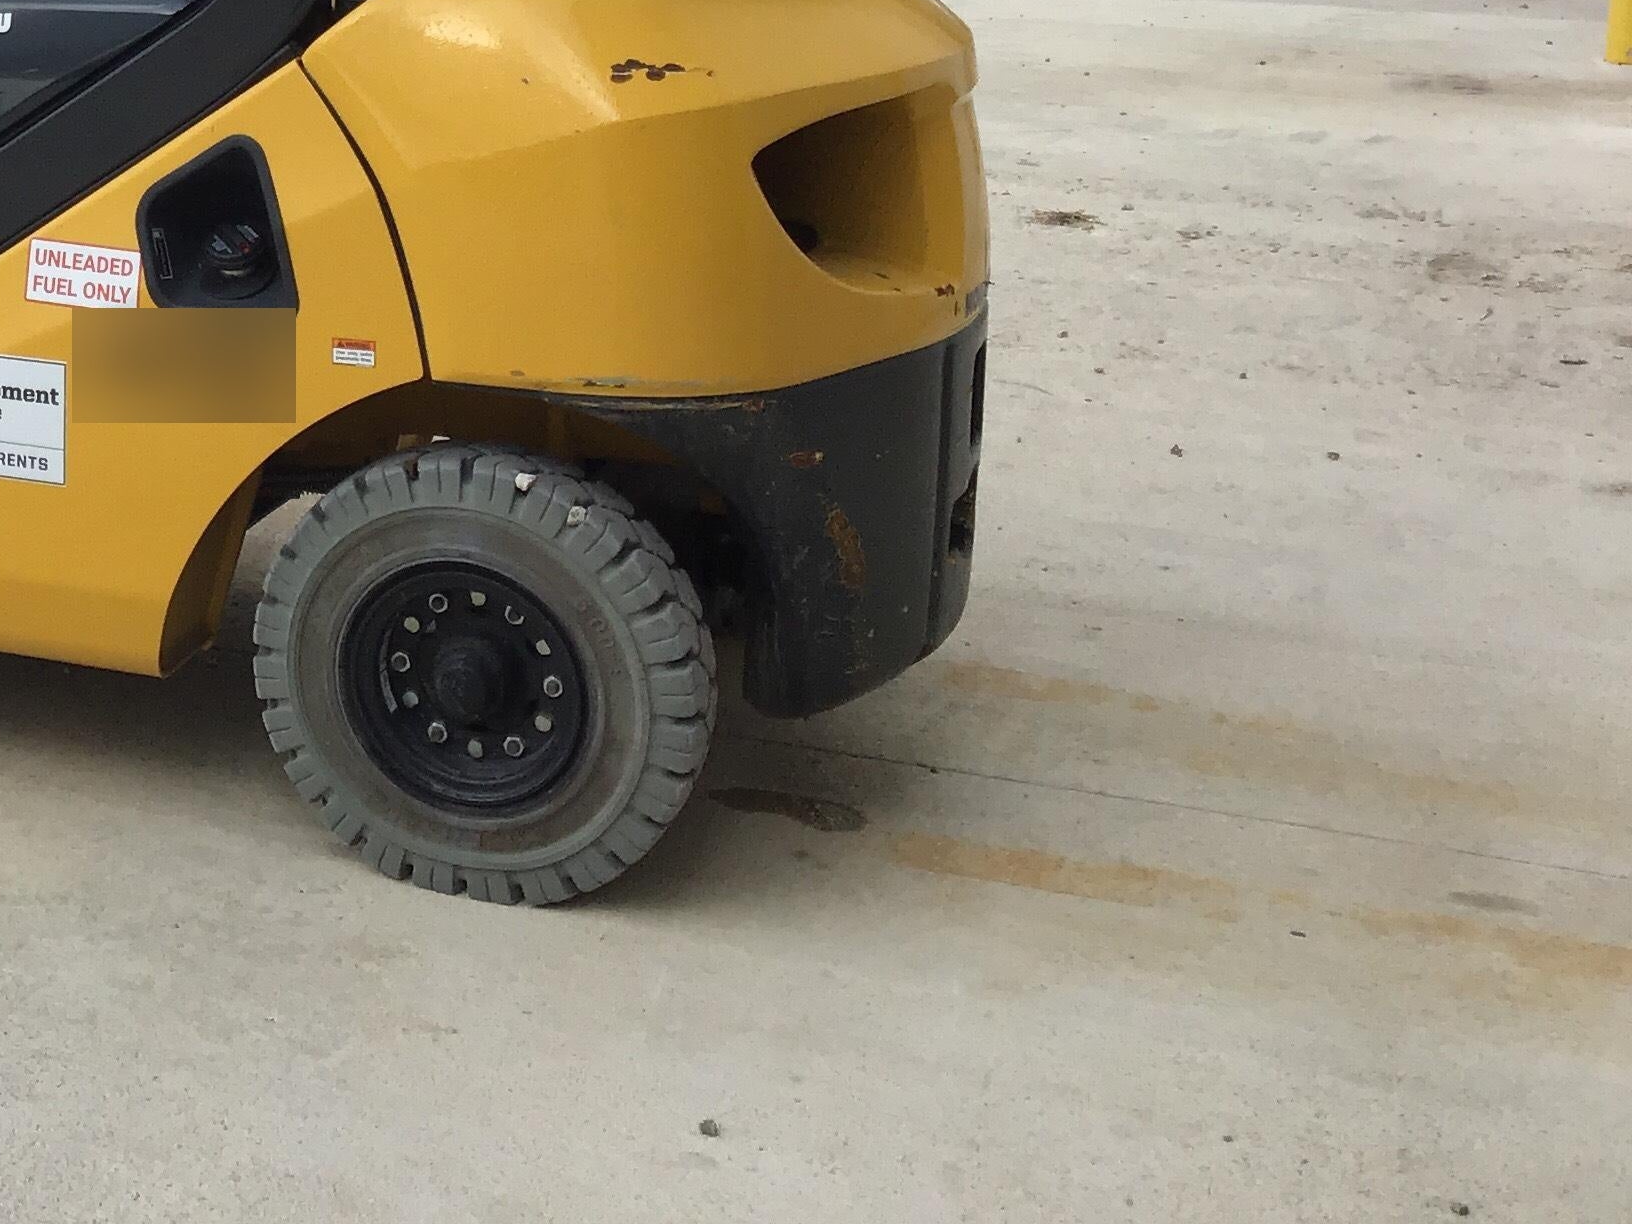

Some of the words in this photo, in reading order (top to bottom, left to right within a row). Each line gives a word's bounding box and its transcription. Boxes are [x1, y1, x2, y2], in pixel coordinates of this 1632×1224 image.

[35, 247, 134, 277] UNLEADED
[32, 275, 78, 297] FUEL
[83, 281, 132, 305] ONLY
